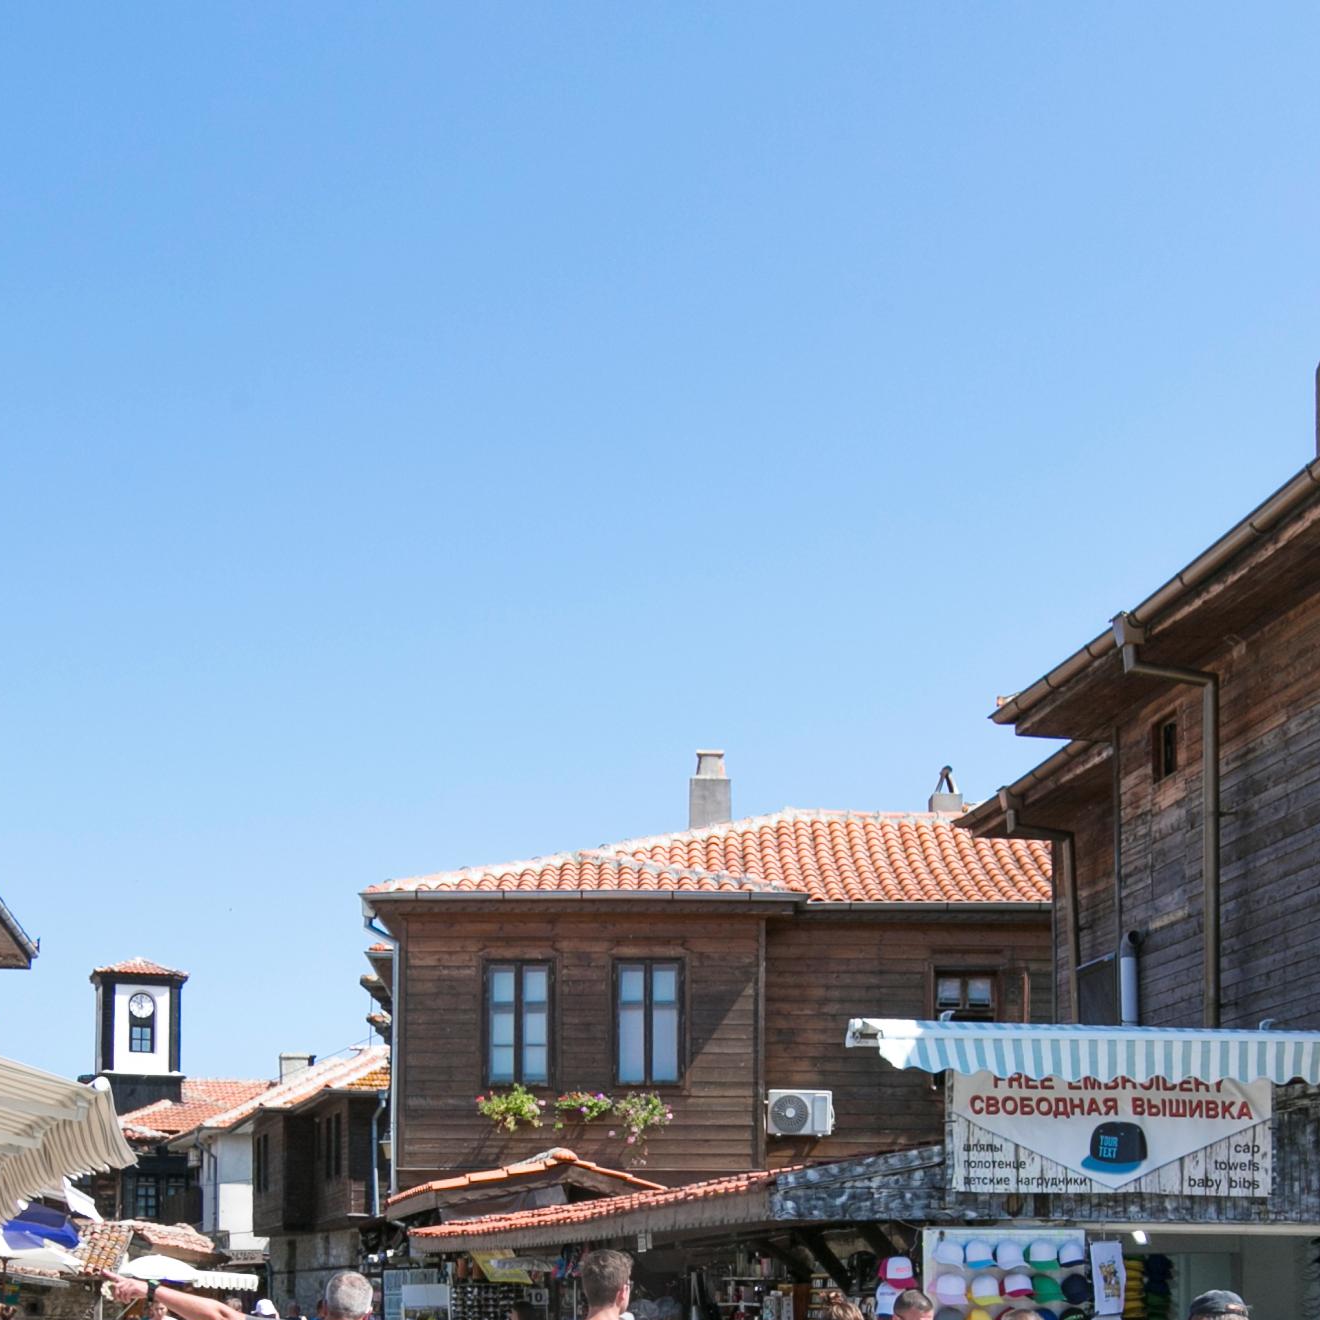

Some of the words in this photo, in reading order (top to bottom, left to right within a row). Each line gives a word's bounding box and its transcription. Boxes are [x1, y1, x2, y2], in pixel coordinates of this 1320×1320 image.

[969, 1095, 1119, 1119] СВОБОДНАЯ
[1131, 1096, 1254, 1120] ВЫШИВКА
[963, 1142, 1003, 1153] шляпы
[1098, 1147, 1117, 1159] TEXT
[1234, 1143, 1261, 1157] cap
[963, 1159, 1027, 1170] полотенце
[1214, 1159, 1261, 1172] towels
[963, 1176, 1010, 1186] детские
[1017, 1176, 1088, 1189] нагрудники
[1188, 1175, 1222, 1194] baby
[1228, 1176, 1261, 1190] bibs
